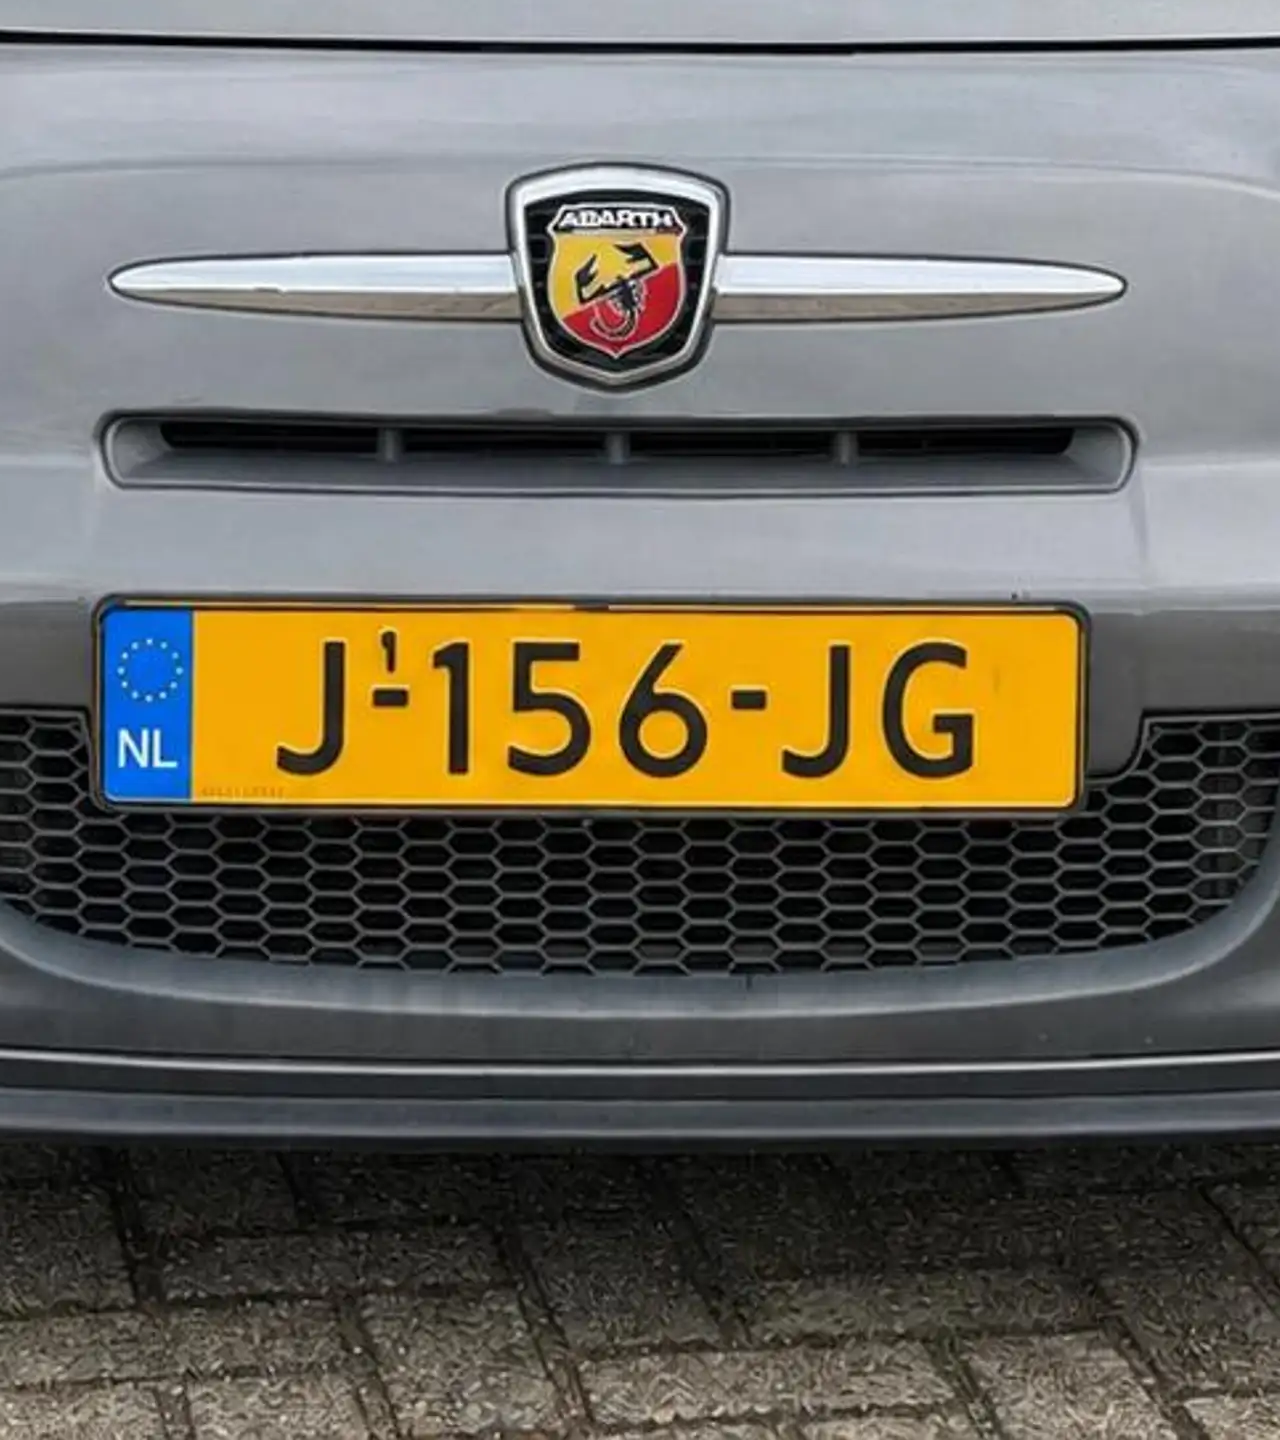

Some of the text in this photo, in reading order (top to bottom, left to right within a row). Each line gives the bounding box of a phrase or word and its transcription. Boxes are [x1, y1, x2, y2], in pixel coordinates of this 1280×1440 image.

[559, 210, 672, 229] ABARTH
[275, 639, 976, 779] J-156-JG
[118, 727, 179, 769] NL
